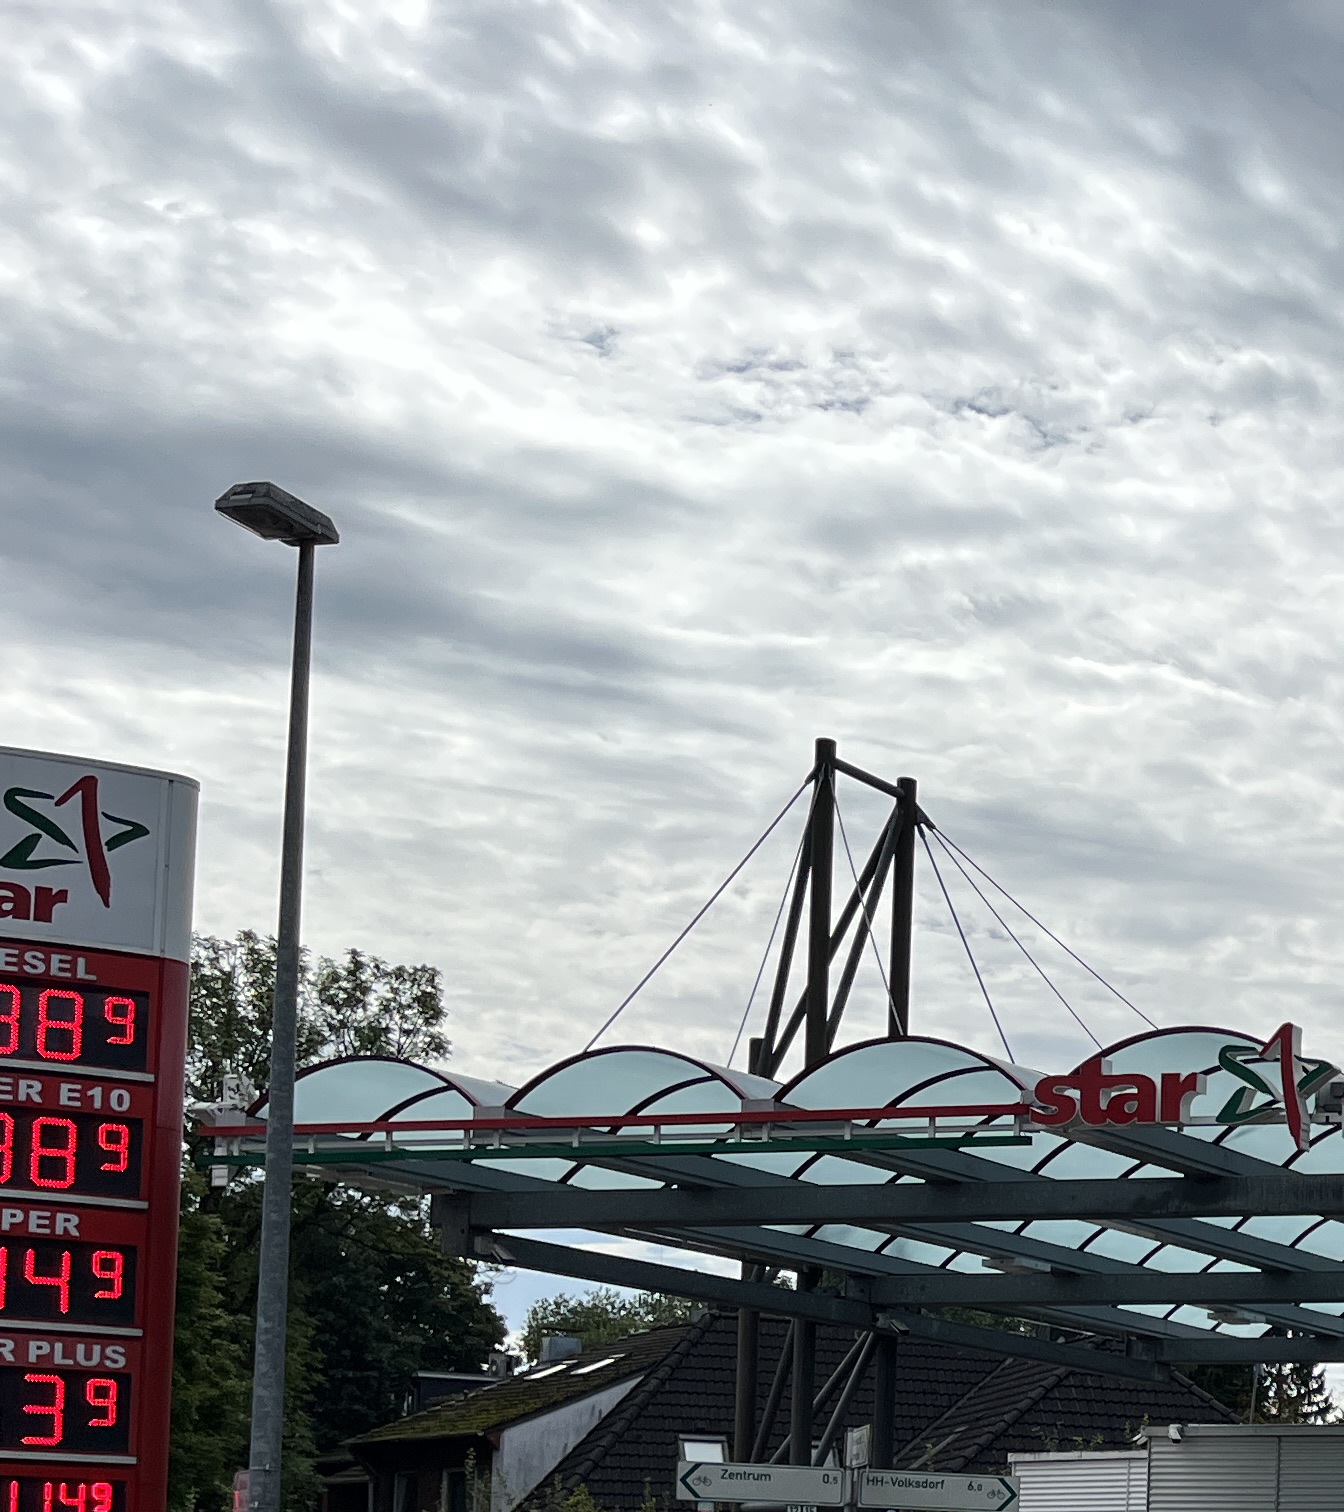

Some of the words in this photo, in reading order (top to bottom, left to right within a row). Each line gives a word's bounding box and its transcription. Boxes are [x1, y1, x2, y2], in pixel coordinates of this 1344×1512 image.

[59, 1082, 131, 1112] E10
[1030, 1056, 1204, 1126] star
[28, 1340, 127, 1369] PLUS
[720, 1469, 772, 1482] Zentrum
[866, 1476, 945, 1490] HH-Volksdorf
